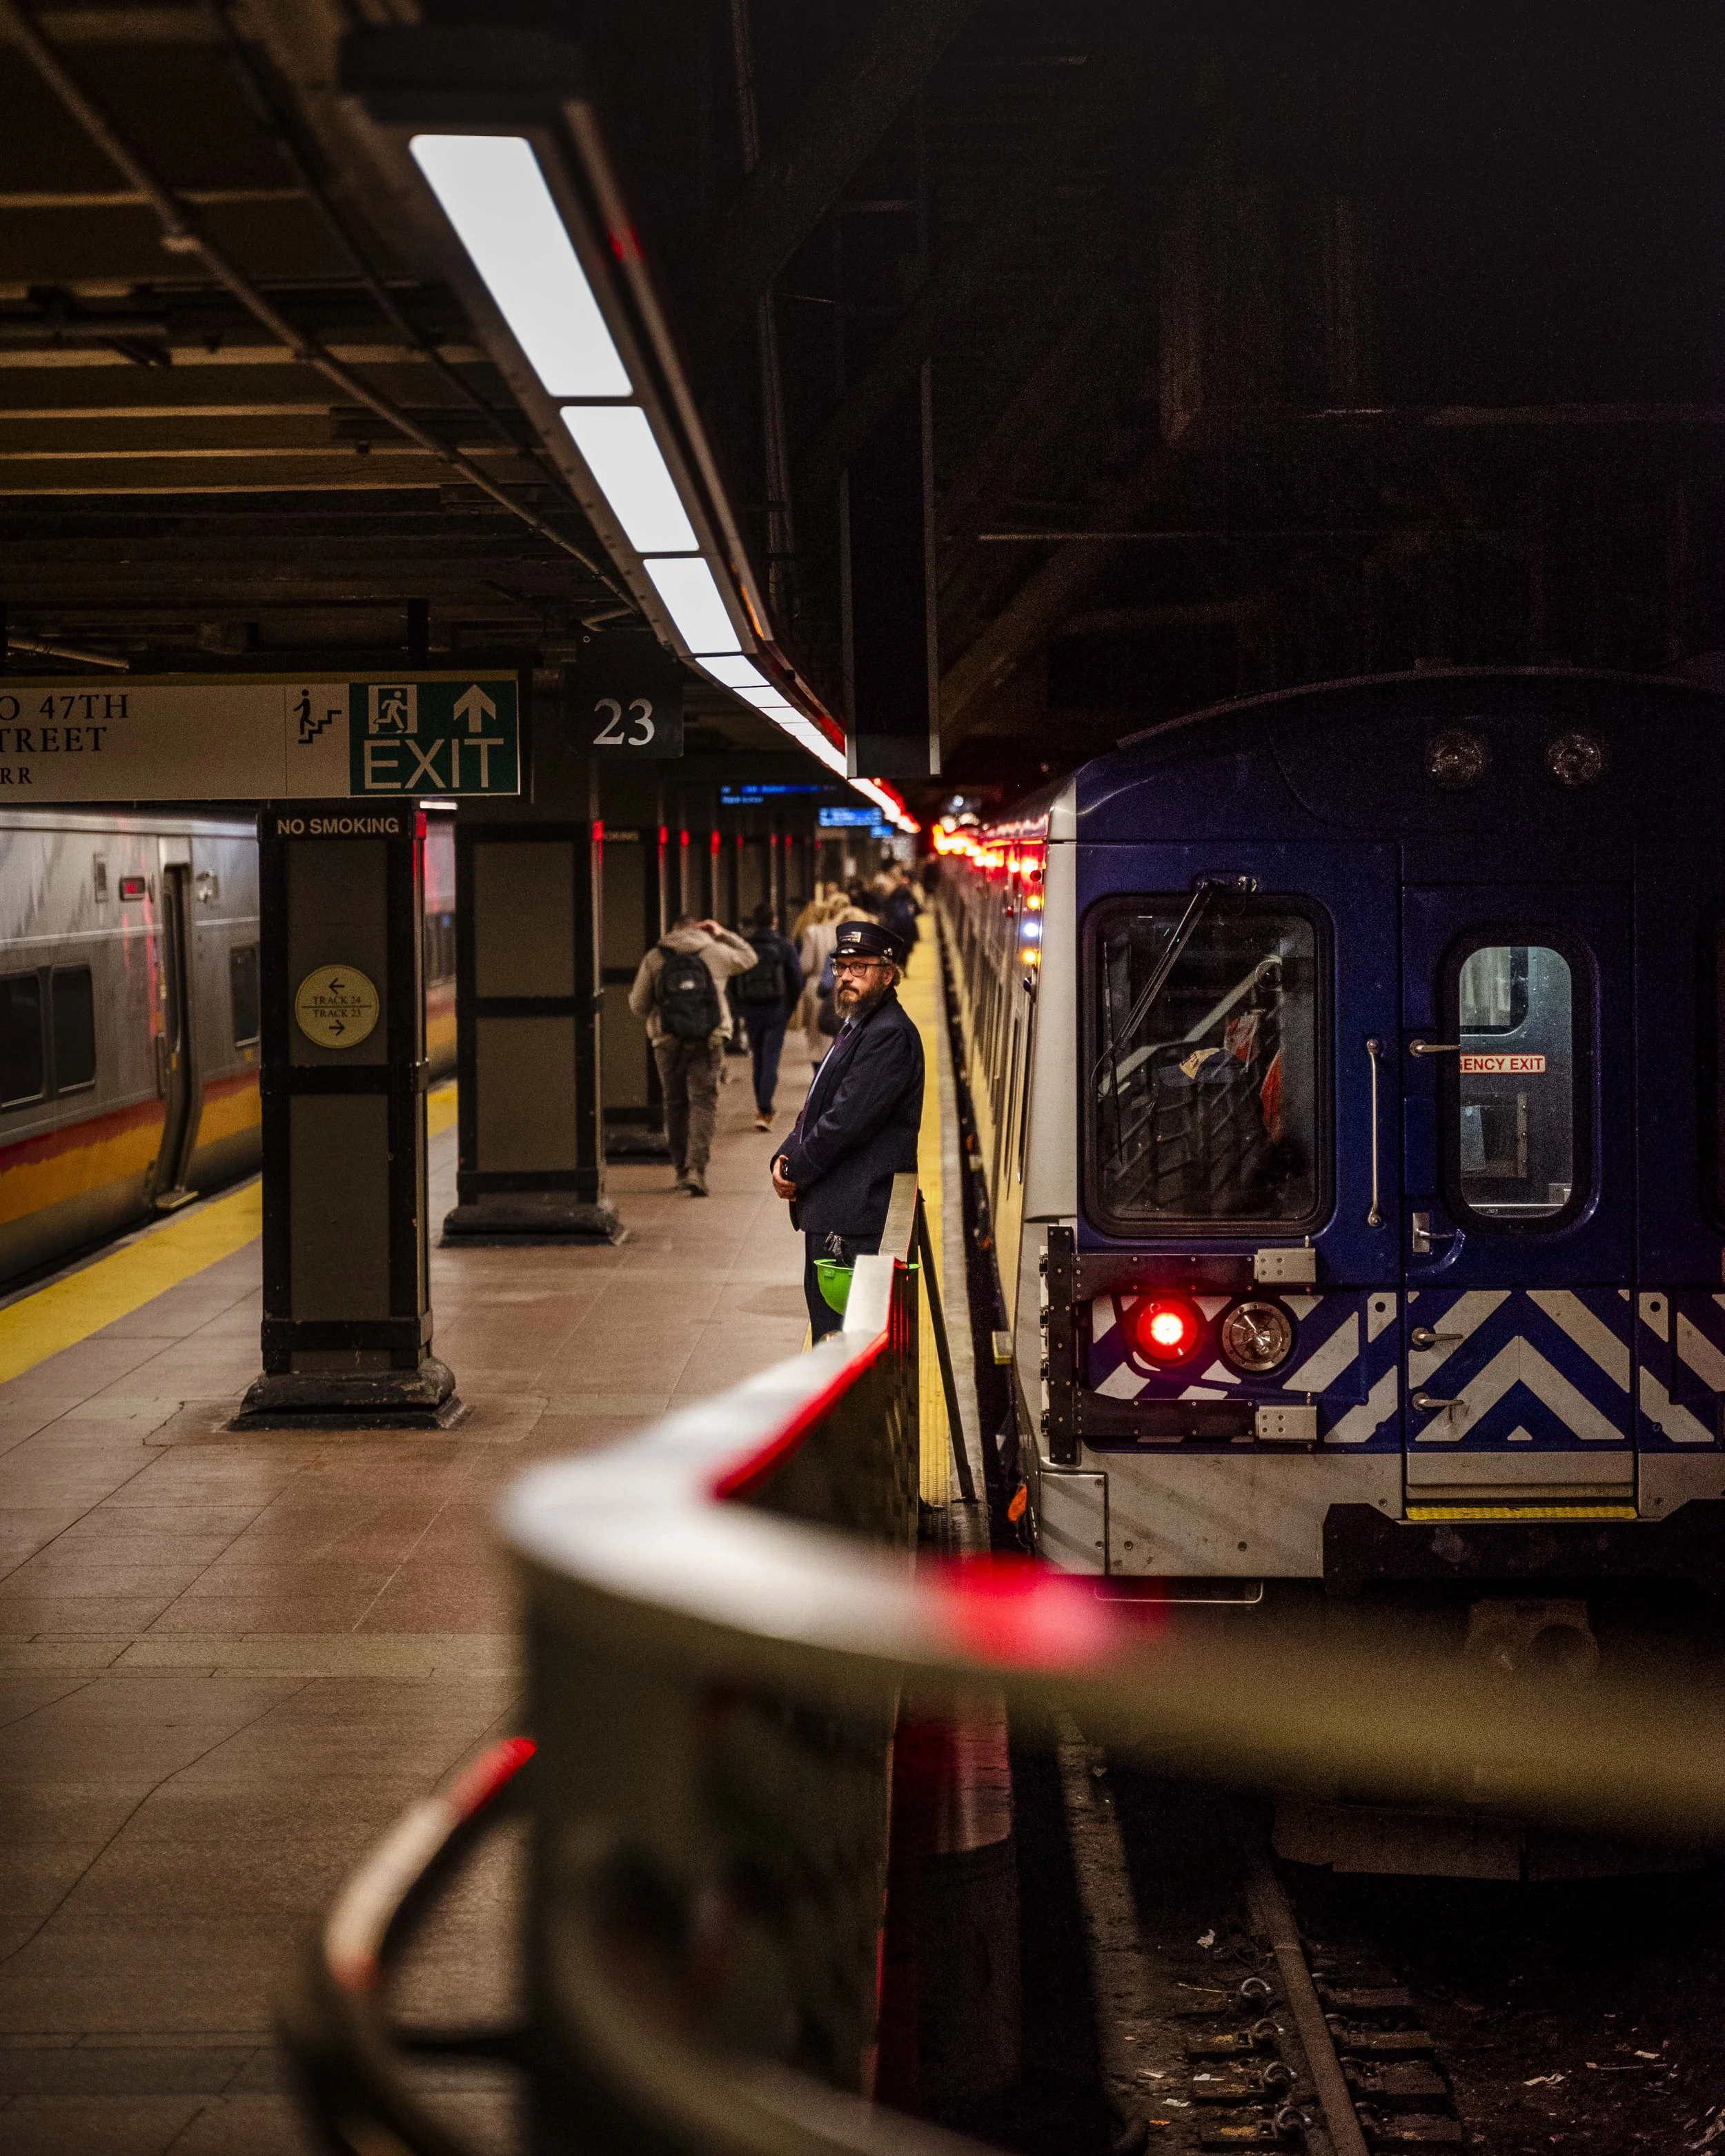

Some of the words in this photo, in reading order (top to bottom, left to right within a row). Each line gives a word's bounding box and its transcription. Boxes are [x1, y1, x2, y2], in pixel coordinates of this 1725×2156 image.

[39, 694, 130, 720] 47TH
[593, 698, 656, 746] 23
[363, 738, 504, 789] EXIT
[277, 818, 305, 835] NO
[308, 817, 400, 835] SMOKING
[313, 996, 348, 1005] TRACK
[313, 1009, 348, 1018] TRACK
[1459, 1058, 1505, 1071] ENCY
[1510, 1058, 1544, 1071] EXIT
